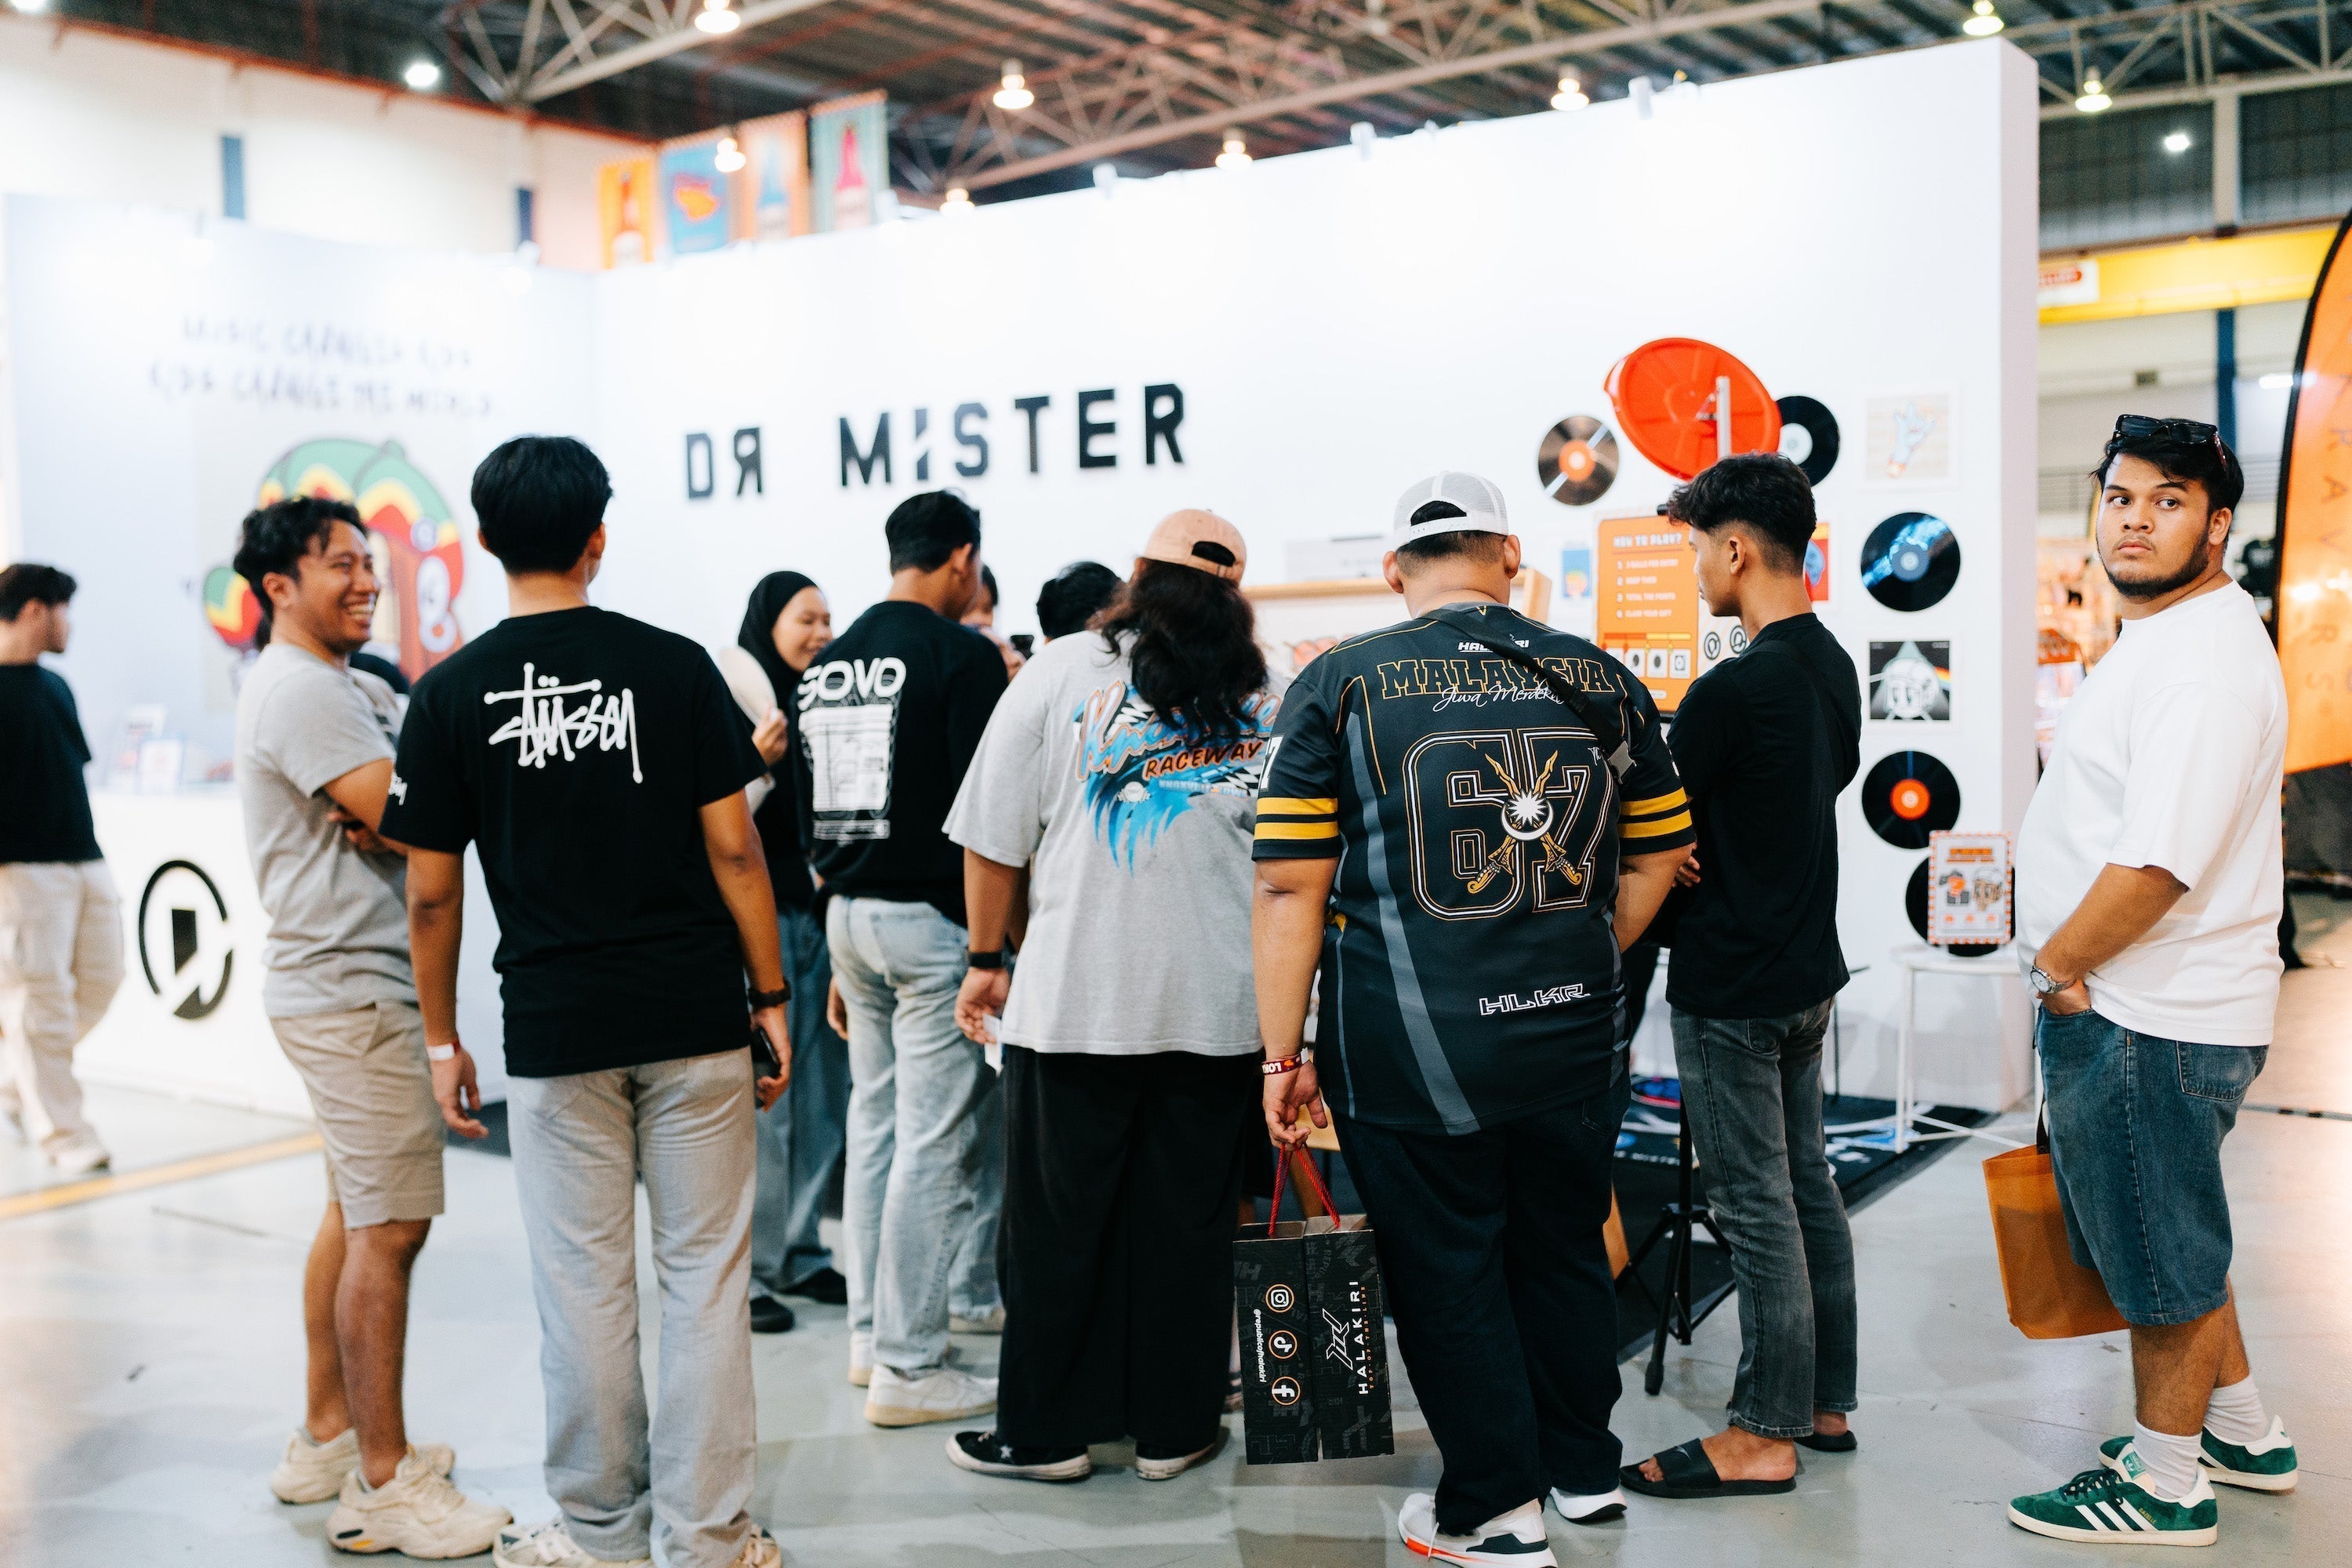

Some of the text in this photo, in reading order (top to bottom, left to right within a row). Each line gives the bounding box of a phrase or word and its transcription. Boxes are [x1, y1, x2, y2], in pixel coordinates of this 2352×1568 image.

[839, 383, 1185, 488] MISTER
[1144, 741, 1264, 781] RACEWAY
[1402, 726, 1613, 921] 67
[1348, 1281, 1369, 1395] HALAKIRI
